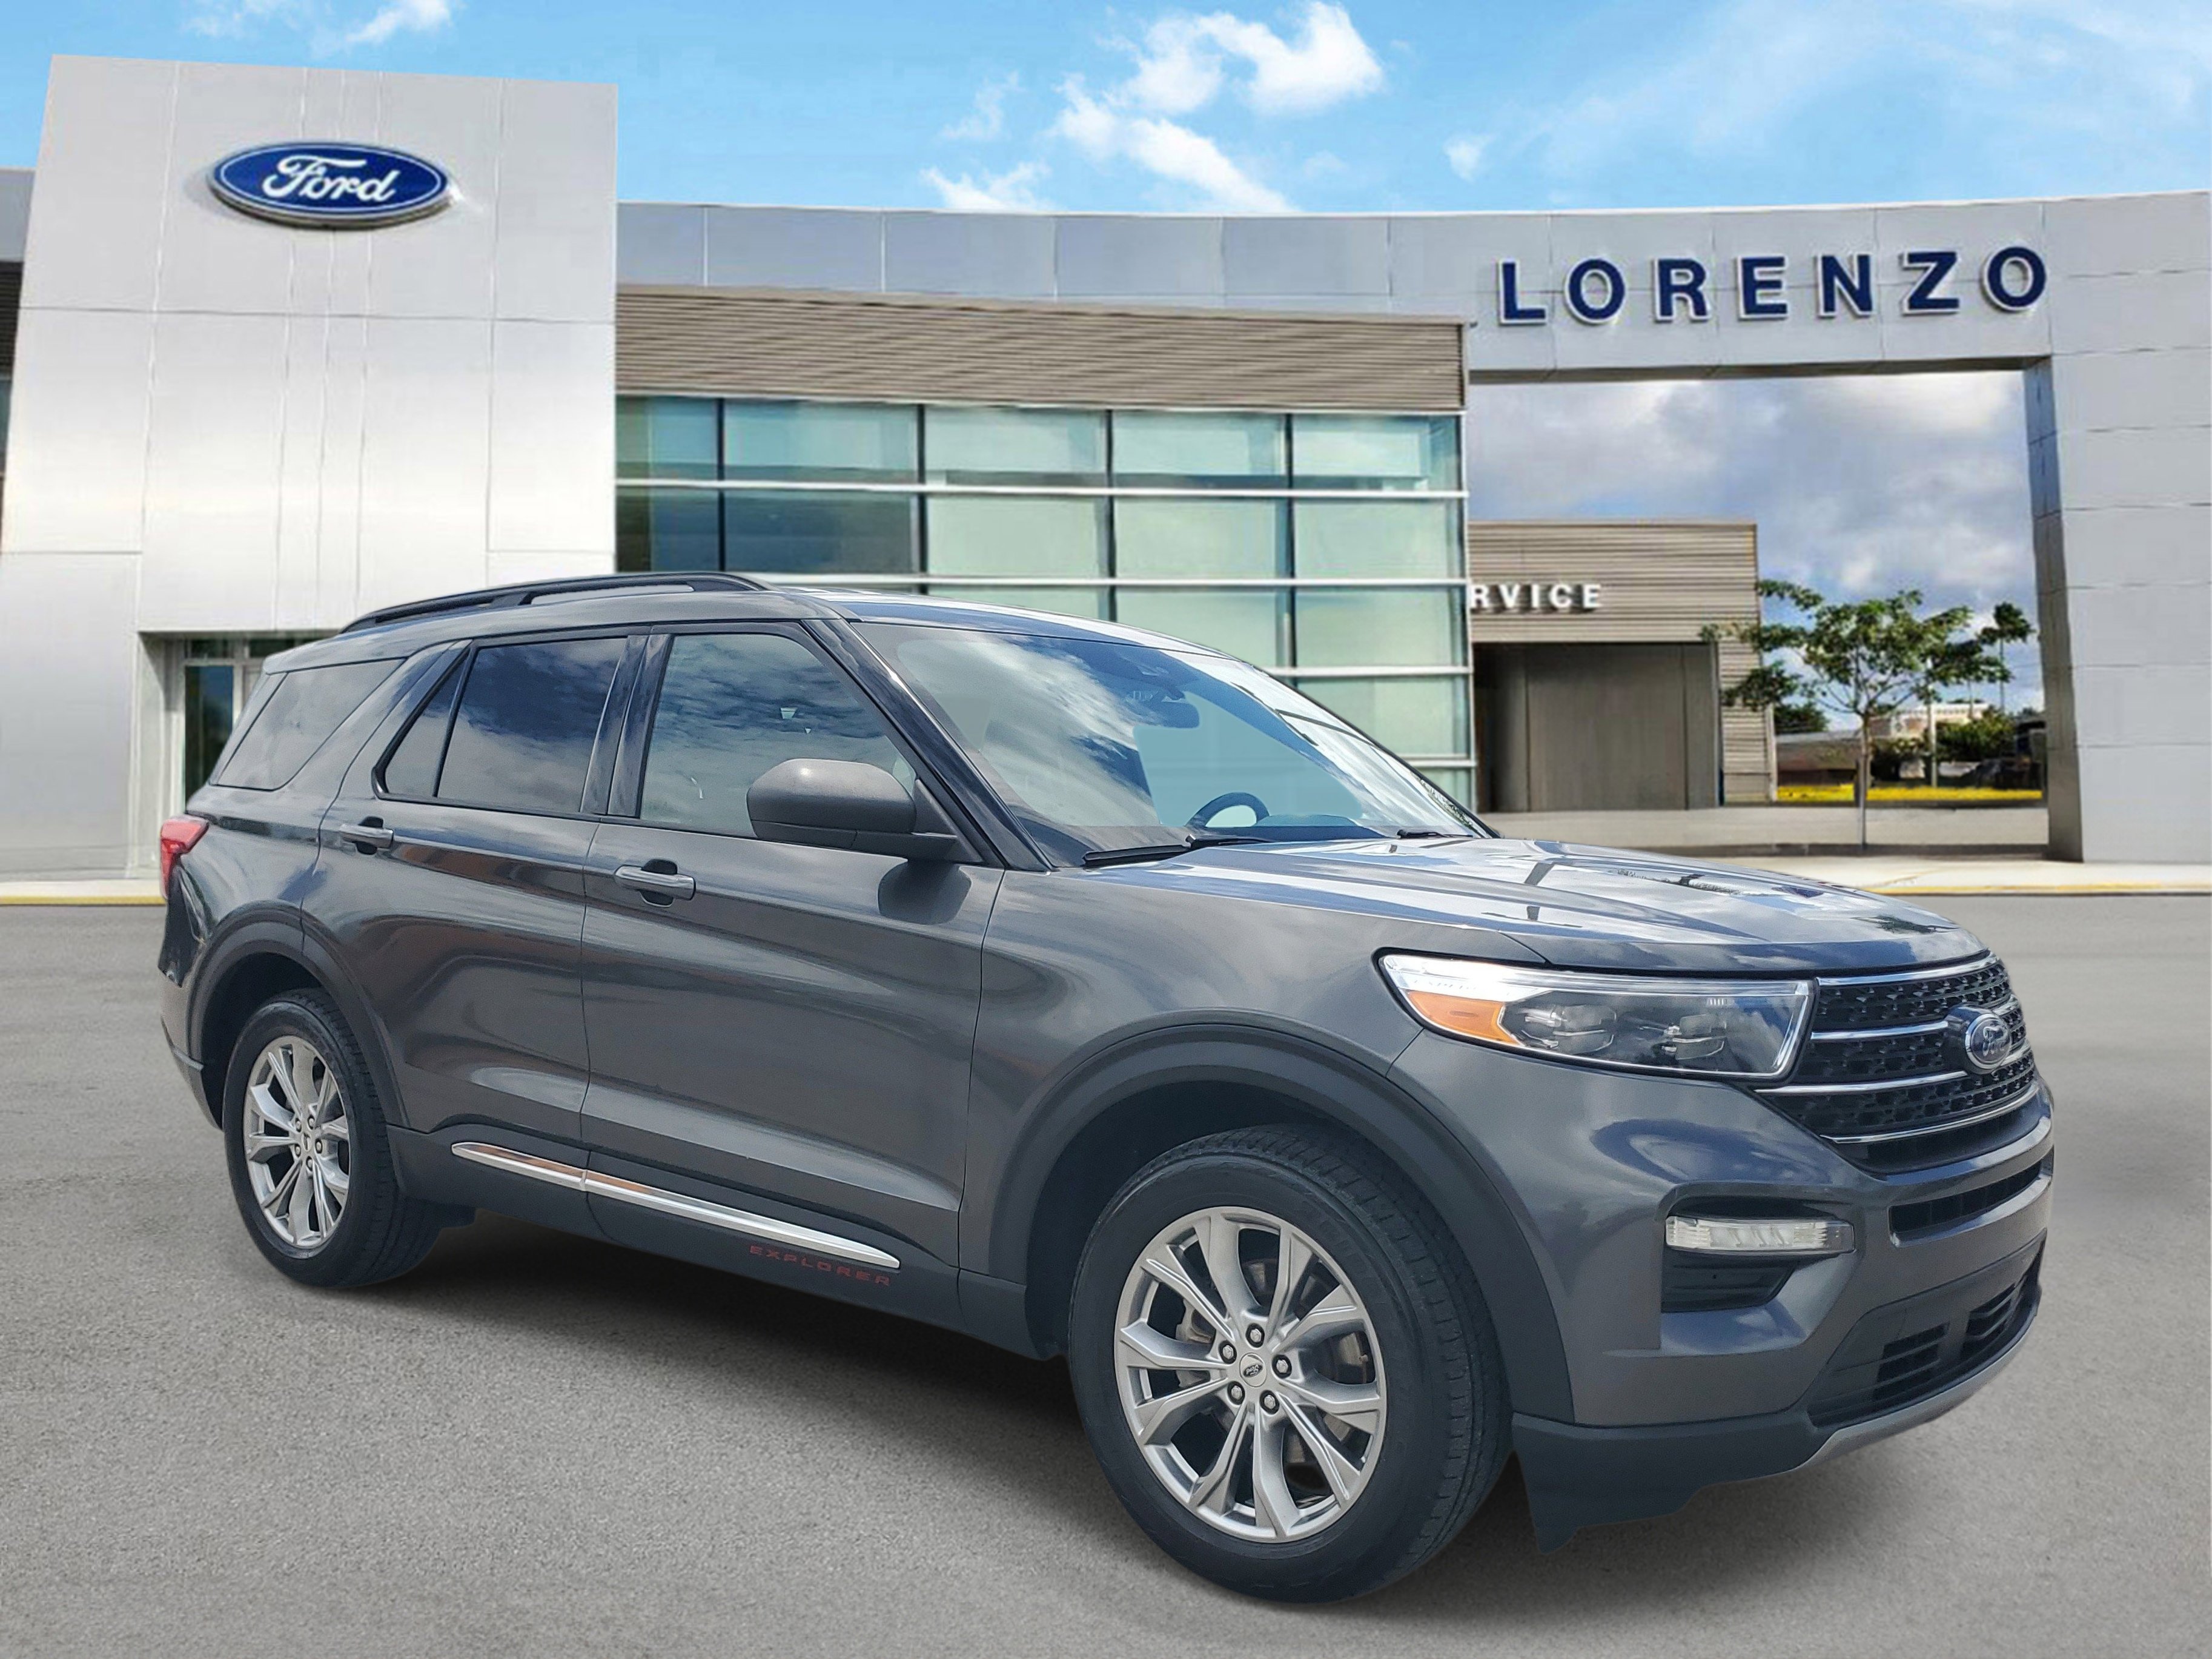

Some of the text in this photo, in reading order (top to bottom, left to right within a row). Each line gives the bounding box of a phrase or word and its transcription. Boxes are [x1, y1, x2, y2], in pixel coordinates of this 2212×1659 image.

[262, 154, 400, 202] Ford
[1498, 246, 2047, 323] LORENZO
[1471, 584, 1602, 608] RVICE
[750, 1245, 890, 1286] EXPLORER
